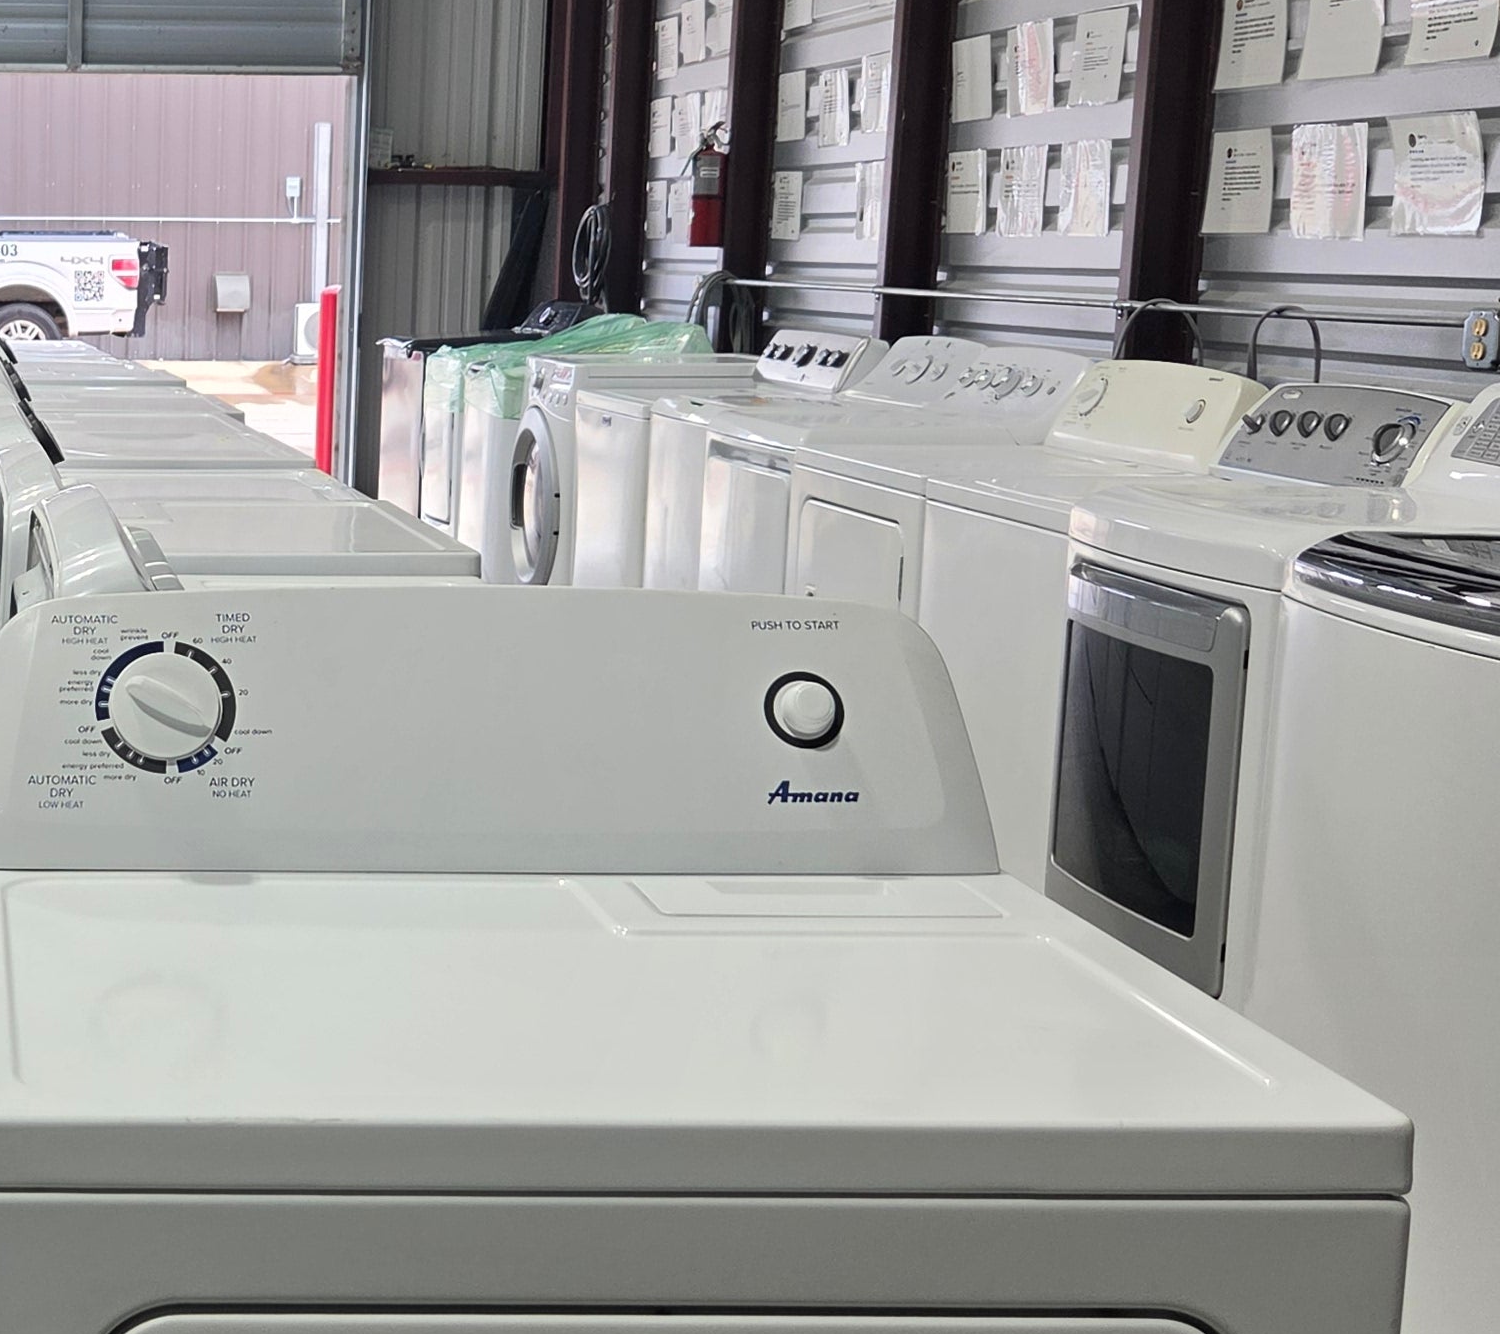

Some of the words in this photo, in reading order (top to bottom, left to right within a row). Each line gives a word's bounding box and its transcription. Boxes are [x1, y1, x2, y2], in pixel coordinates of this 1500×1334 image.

[51, 615, 118, 624] AUTOMATIC
[215, 613, 251, 622] TIMED
[221, 624, 245, 634] DRY
[751, 620, 782, 630] PUSH
[785, 620, 801, 630] TO
[804, 620, 840, 630] START
[73, 626, 97, 636] DRY
[235, 635, 257, 643] HEAT
[77, 725, 96, 733] OFF
[224, 747, 242, 755] OFF
[27, 775, 97, 785] AUTOMATIC
[164, 776, 182, 784] OFF
[209, 777, 228, 787] AIR
[231, 777, 255, 787] DRY
[49, 787, 74, 798] DRY
[212, 790, 226, 798] NO
[228, 790, 251, 798] HEAT
[767, 780, 860, 805] Amana
[38, 800, 59, 809] LOW
[60, 800, 84, 809] HEAT
